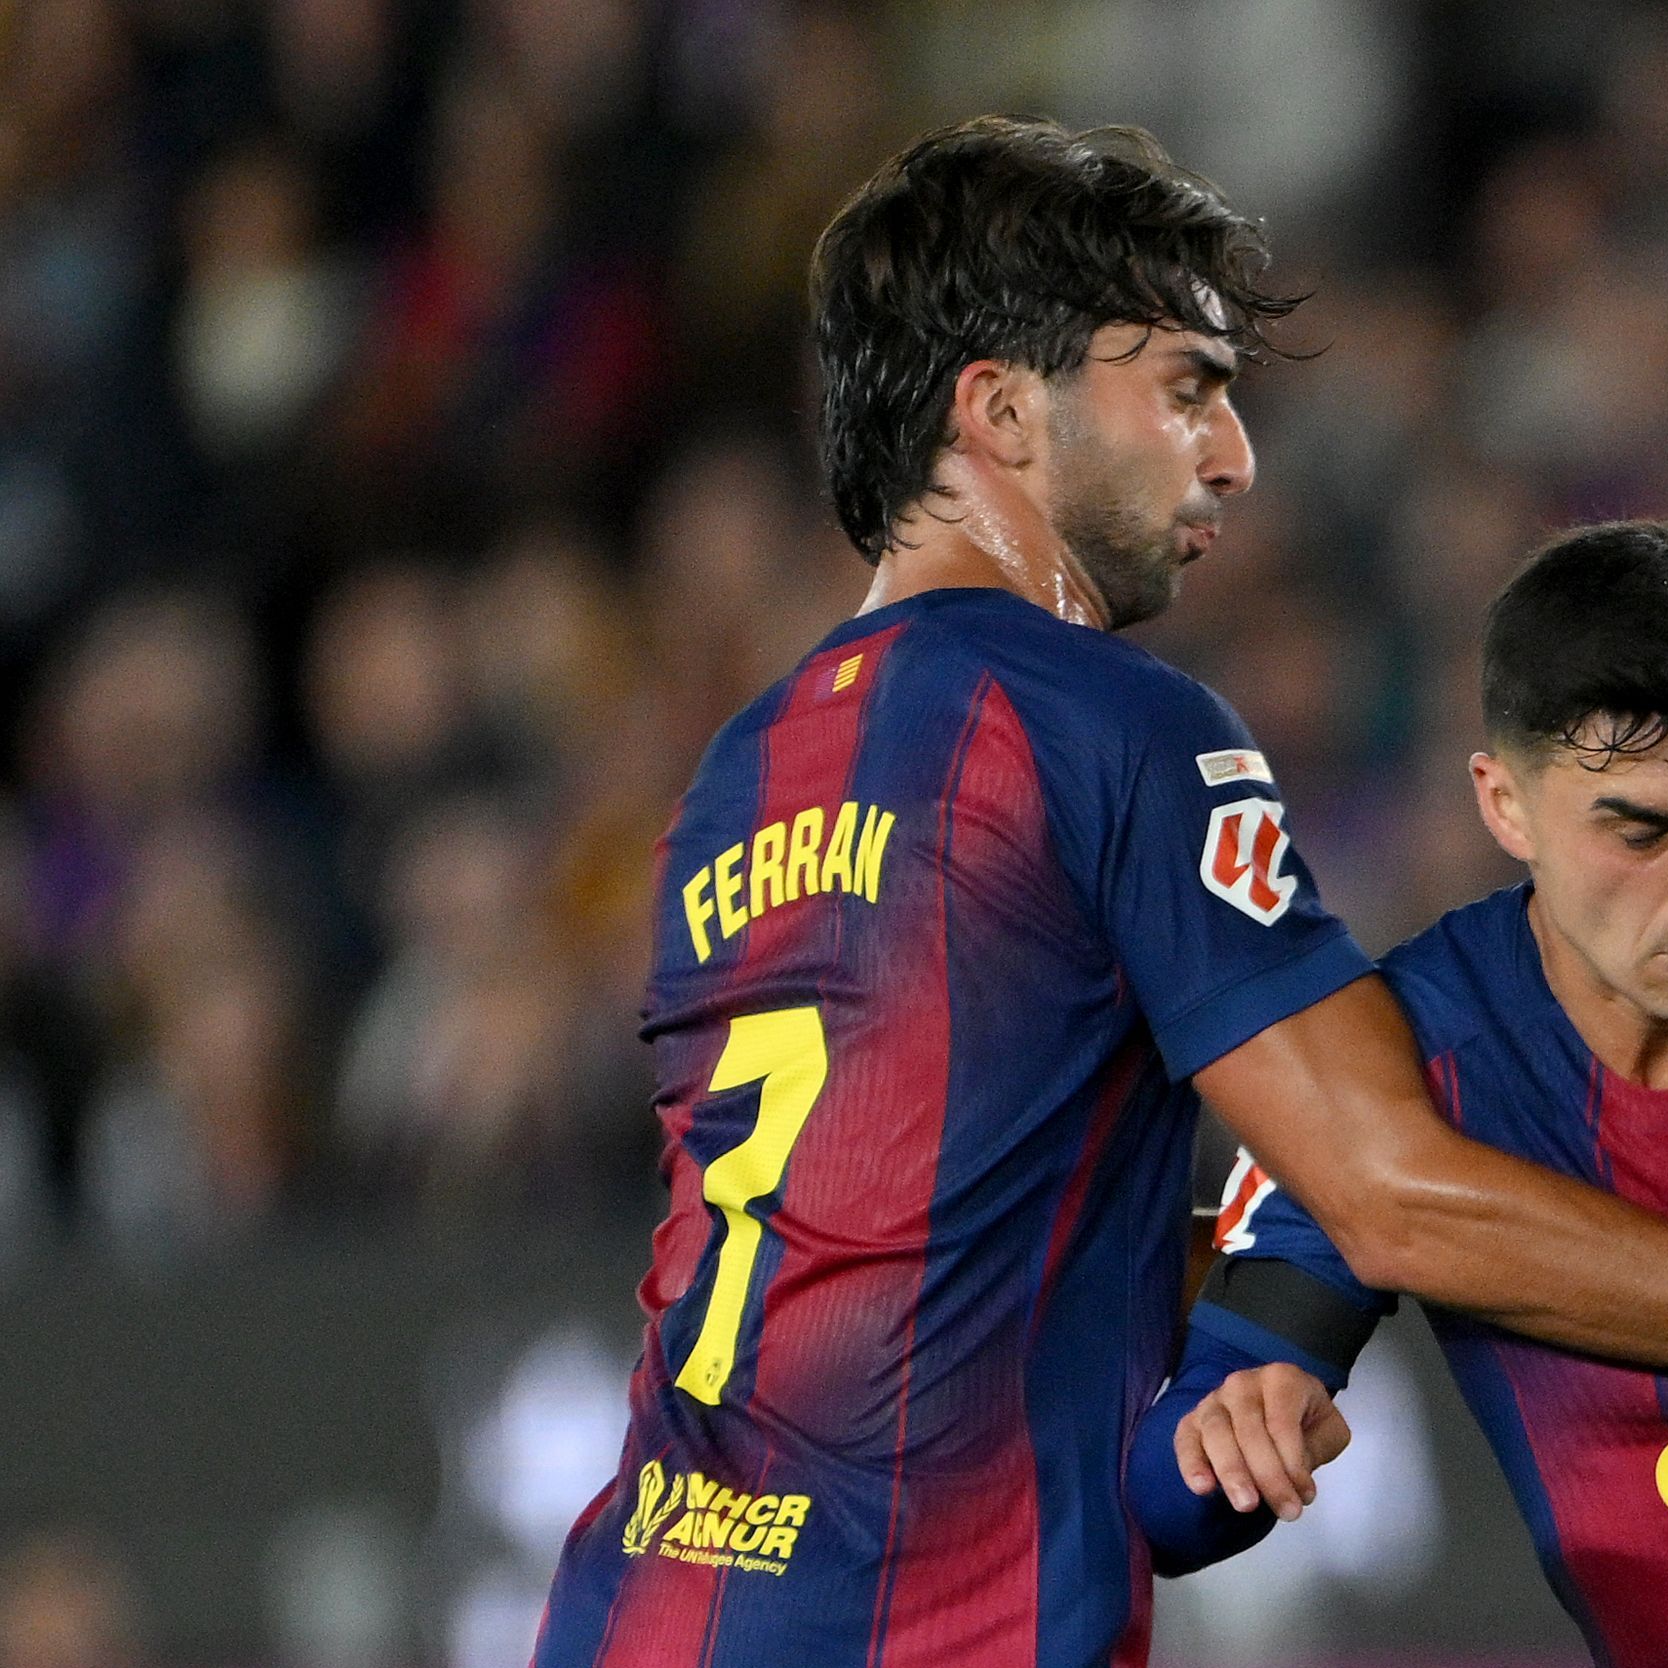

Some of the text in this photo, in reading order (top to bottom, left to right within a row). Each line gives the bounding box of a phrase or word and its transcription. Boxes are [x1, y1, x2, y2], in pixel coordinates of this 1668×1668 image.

[682, 801, 895, 963] FERRAN
[675, 1006, 828, 1406] 7
[686, 1472, 812, 1526] NHCR
[734, 1554, 787, 1576] Agency
